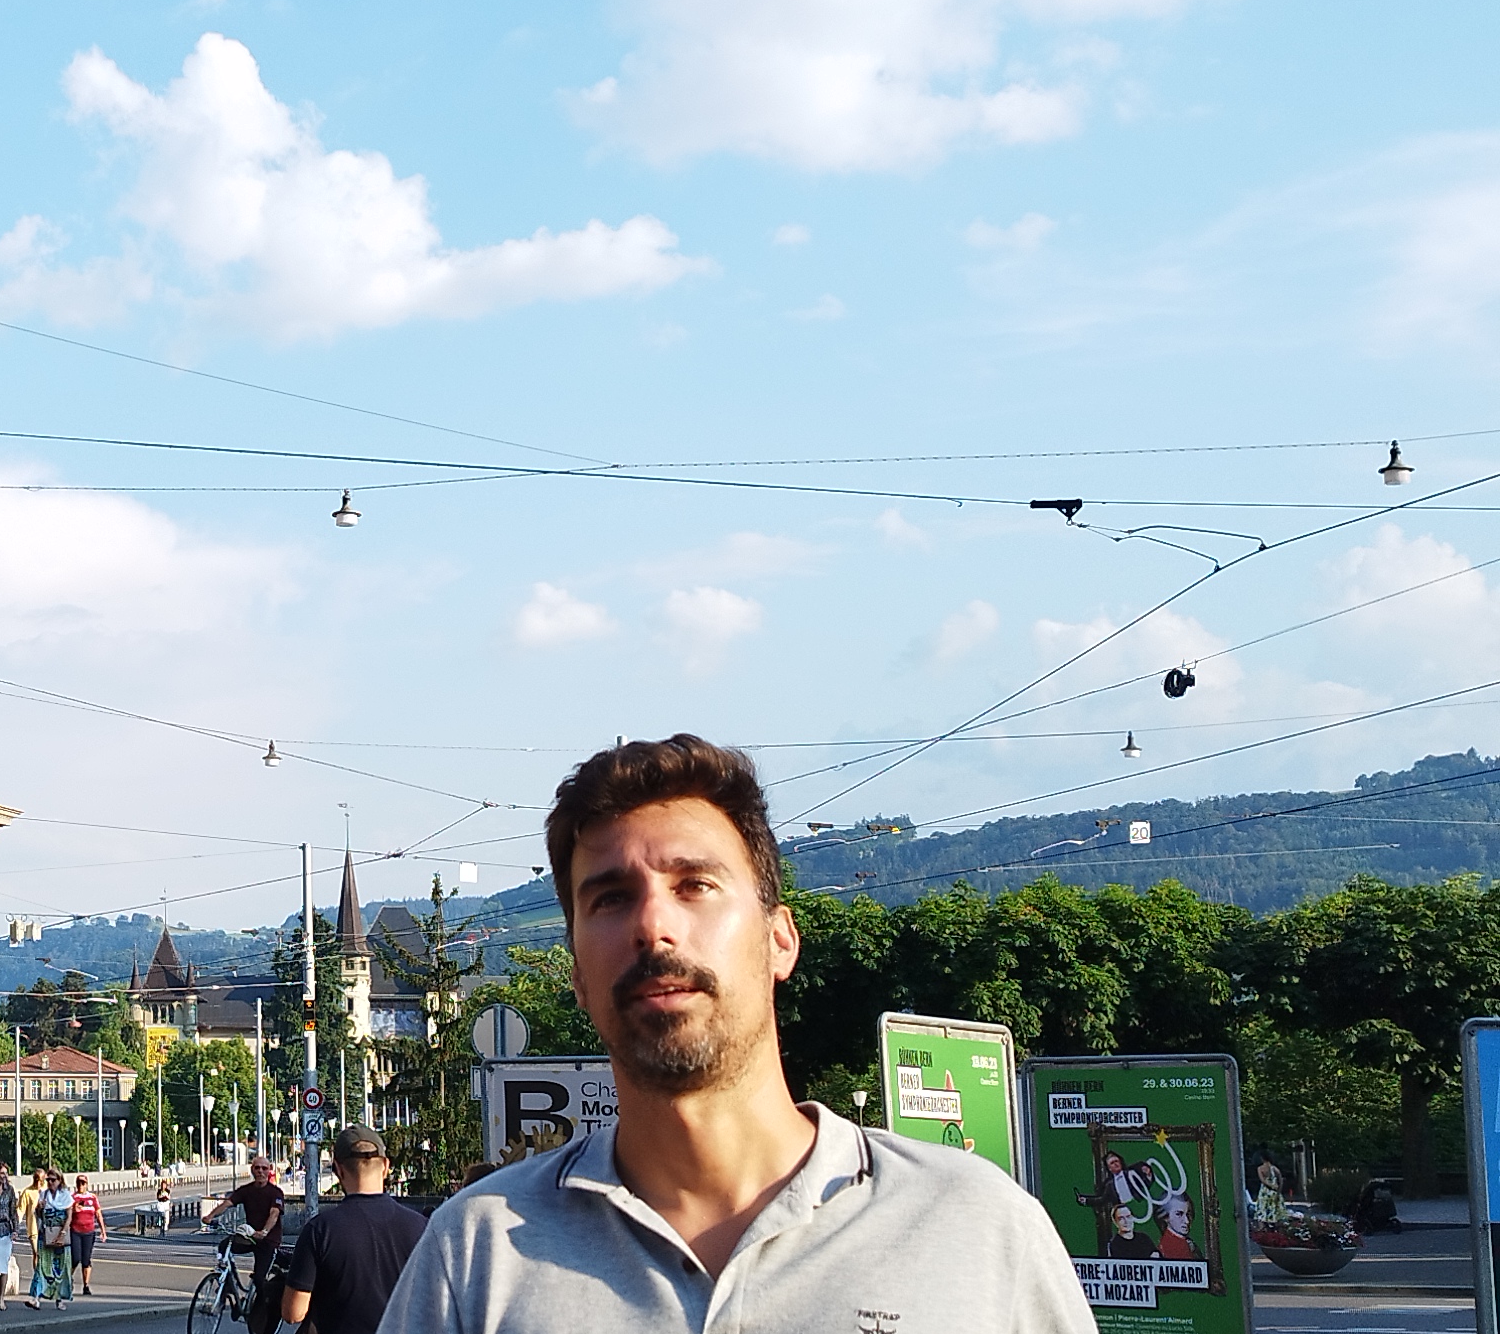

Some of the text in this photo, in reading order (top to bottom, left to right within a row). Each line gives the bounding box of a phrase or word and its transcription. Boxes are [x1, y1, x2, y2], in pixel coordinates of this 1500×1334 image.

[1131, 827, 1148, 840] 20
[1143, 1078, 1159, 1089] 29.
[1159, 1078, 1168, 1088] &
[309, 1095, 317, 1103] 40
[1052, 1097, 1083, 1110] BERNER
[504, 1080, 574, 1149] B
[1053, 1111, 1144, 1125] SYMPHONIEORCHESTER
[1073, 1263, 1203, 1284] ERRE-LAURENT AIMARD
[1084, 1283, 1150, 1302] ELT MOZART
